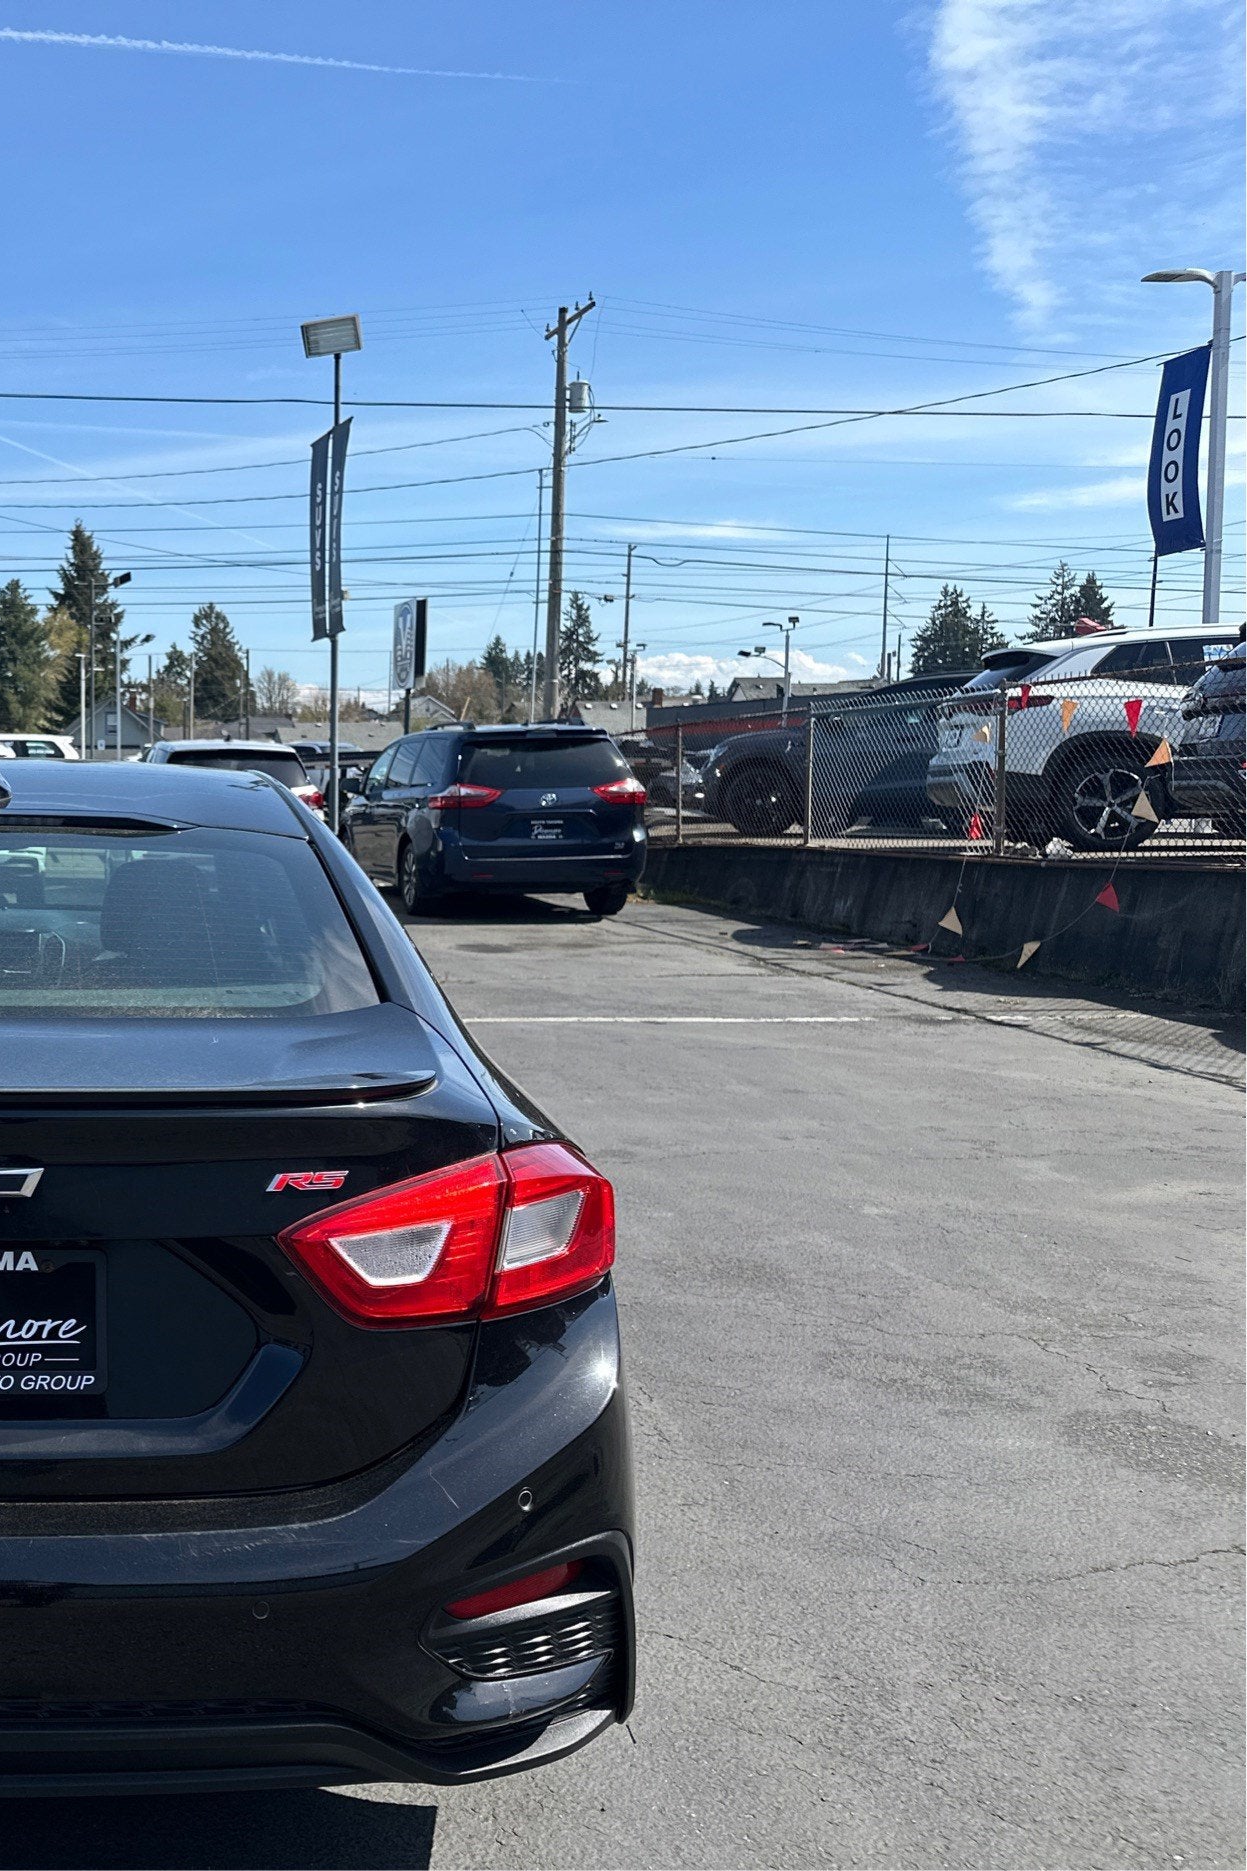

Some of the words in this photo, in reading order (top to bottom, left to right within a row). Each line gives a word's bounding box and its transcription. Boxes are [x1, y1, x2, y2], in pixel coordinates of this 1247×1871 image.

[1163, 397, 1183, 516] LOOK
[265, 1170, 350, 1192] RS
[19, 1375, 96, 1391] GROUP
